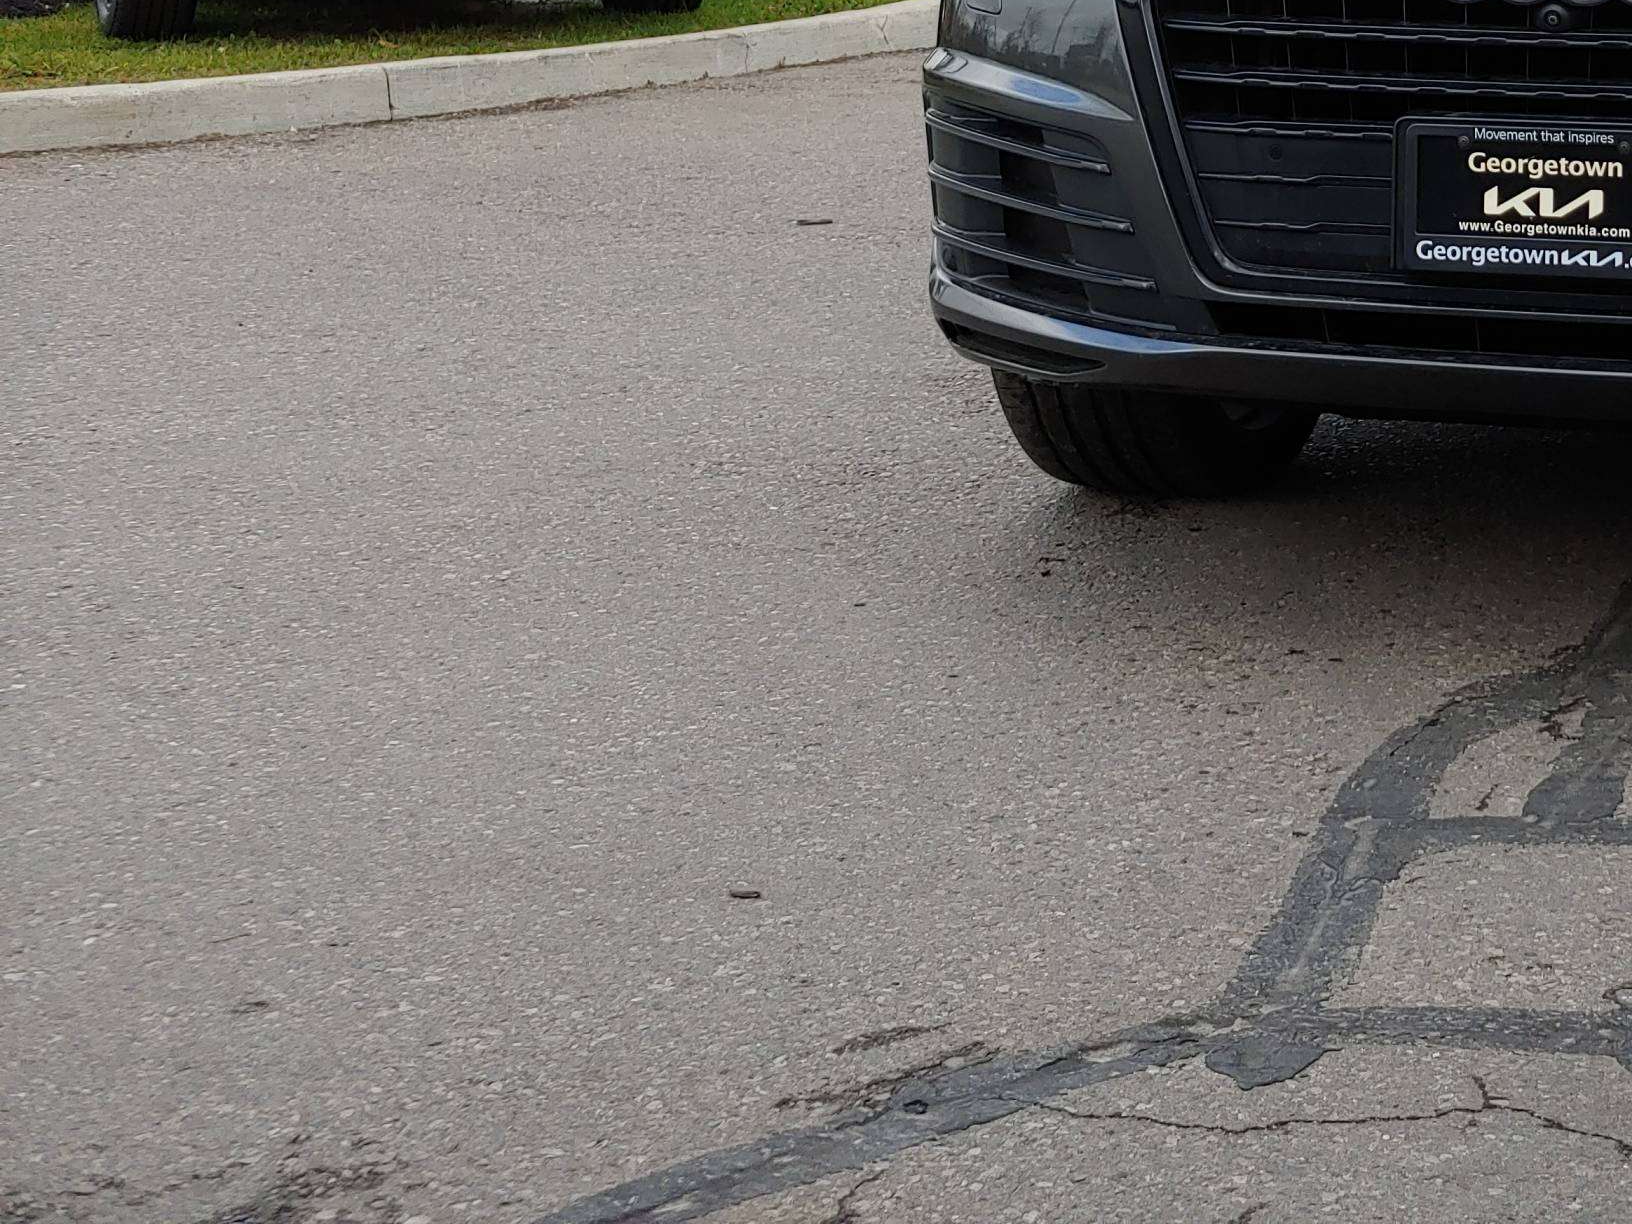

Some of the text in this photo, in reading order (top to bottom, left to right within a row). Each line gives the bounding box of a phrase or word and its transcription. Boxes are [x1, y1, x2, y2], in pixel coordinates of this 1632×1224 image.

[1474, 127, 1614, 145] Movement that inspires
[1468, 152, 1623, 179] Georgetown
[1483, 185, 1604, 219] KIA
[1458, 220, 1631, 238] www.Georgetownkia.com
